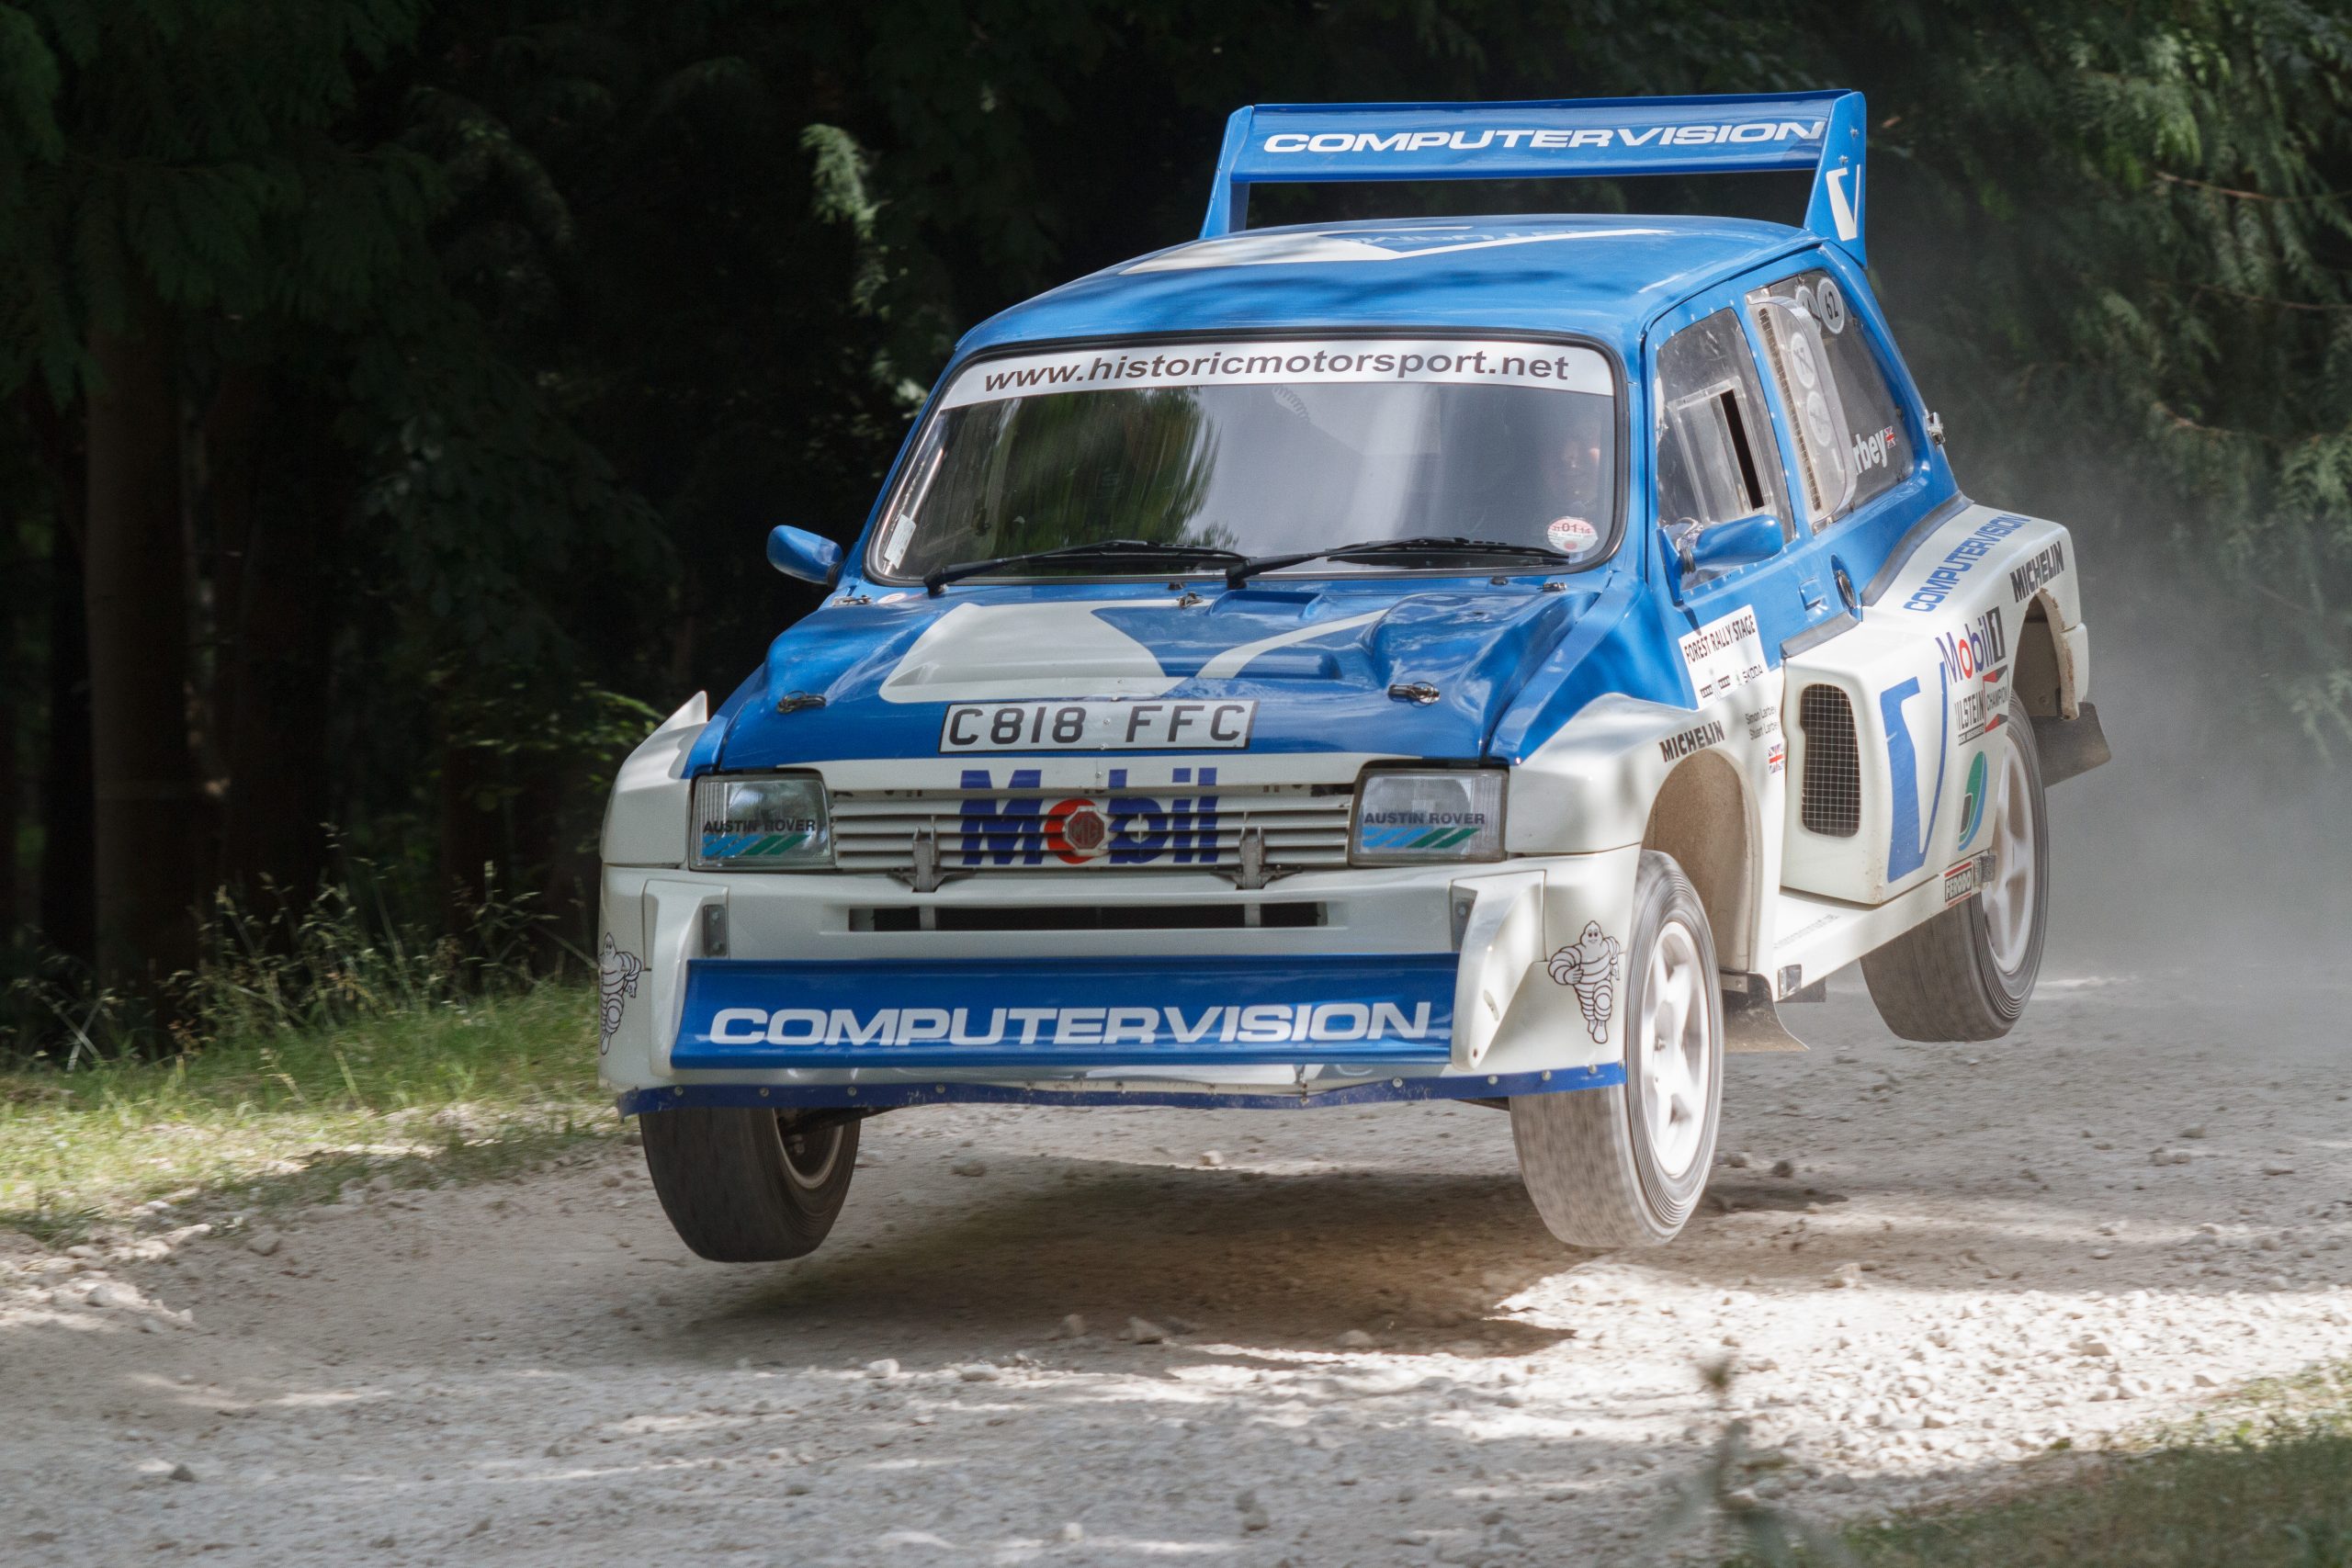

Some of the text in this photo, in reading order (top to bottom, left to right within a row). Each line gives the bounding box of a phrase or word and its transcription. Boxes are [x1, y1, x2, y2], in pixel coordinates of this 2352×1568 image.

[1263, 120, 1826, 153] COMPUTERVISION
[1825, 291, 1839, 320] 62
[985, 349, 1569, 392] www.historicmotorsport.net
[1852, 429, 1887, 476] rbey
[1903, 513, 2031, 613] COMPUTERVISION
[2009, 540, 2065, 603] MICHELIN
[1683, 615, 1756, 664] FOREST RALLY STAGE
[1935, 615, 1994, 685] Mobil
[948, 704, 1247, 746] C818 FFC
[1658, 719, 1725, 763] MICHELIN
[703, 818, 816, 832] AUSTIN ROVER
[1364, 812, 1486, 824] AUSTIN ROVER
[1945, 870, 1972, 900] FERODO
[710, 1002, 1431, 1045] COMPUTERVISION
